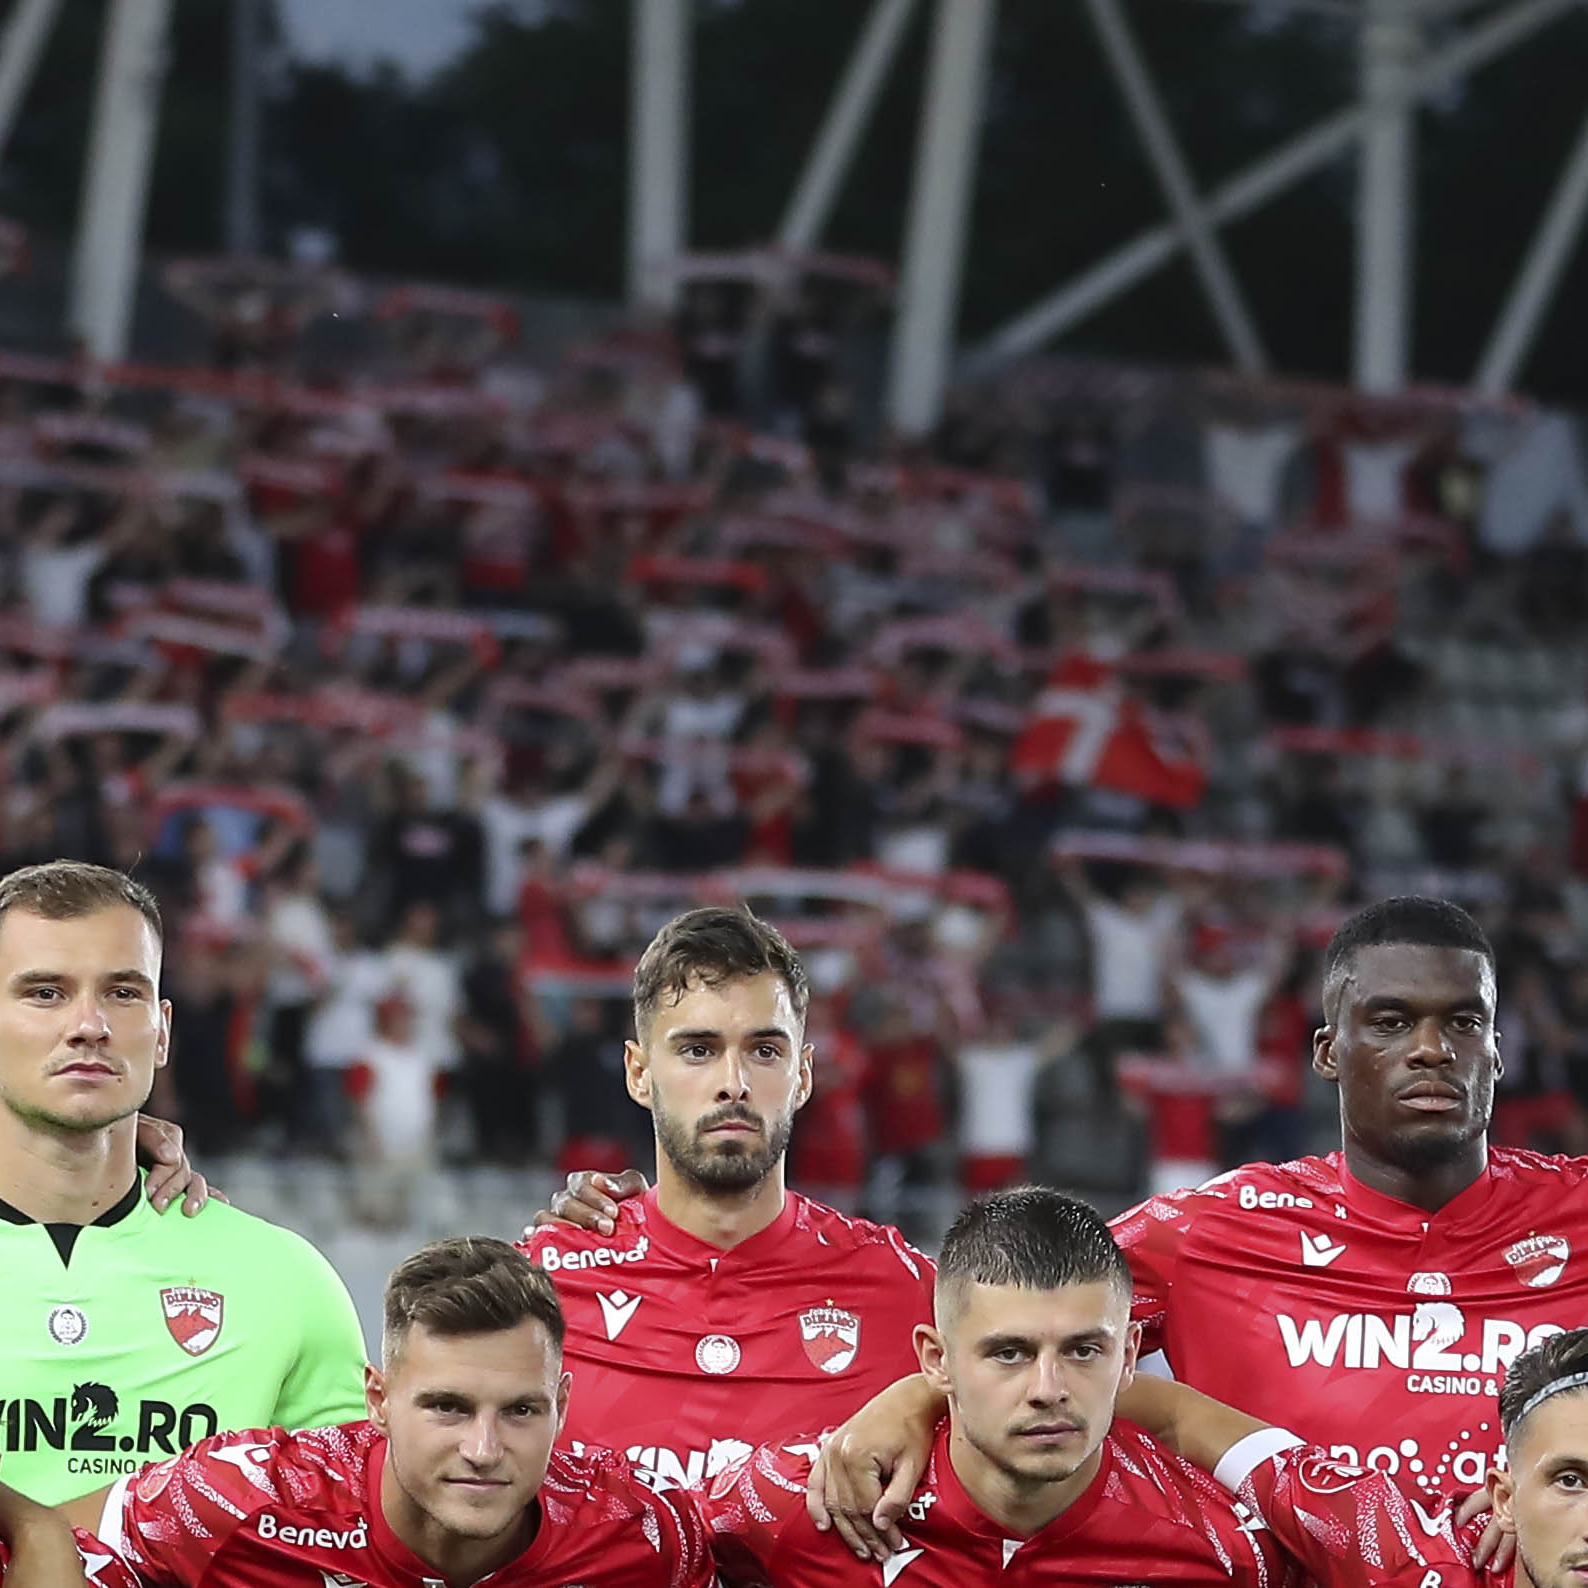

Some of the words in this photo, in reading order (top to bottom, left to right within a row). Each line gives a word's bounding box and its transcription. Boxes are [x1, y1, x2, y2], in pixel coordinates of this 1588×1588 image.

[1239, 1184, 1314, 1210] Bene
[541, 1246, 646, 1271] Beneva
[166, 1293, 219, 1309] DINAMO
[804, 1316, 856, 1329] DINAMO
[1407, 1374, 1481, 1396] CASINO
[1484, 1378, 1498, 1396] &
[68, 1458, 137, 1474] CASINO
[258, 1514, 368, 1549] Beneva
